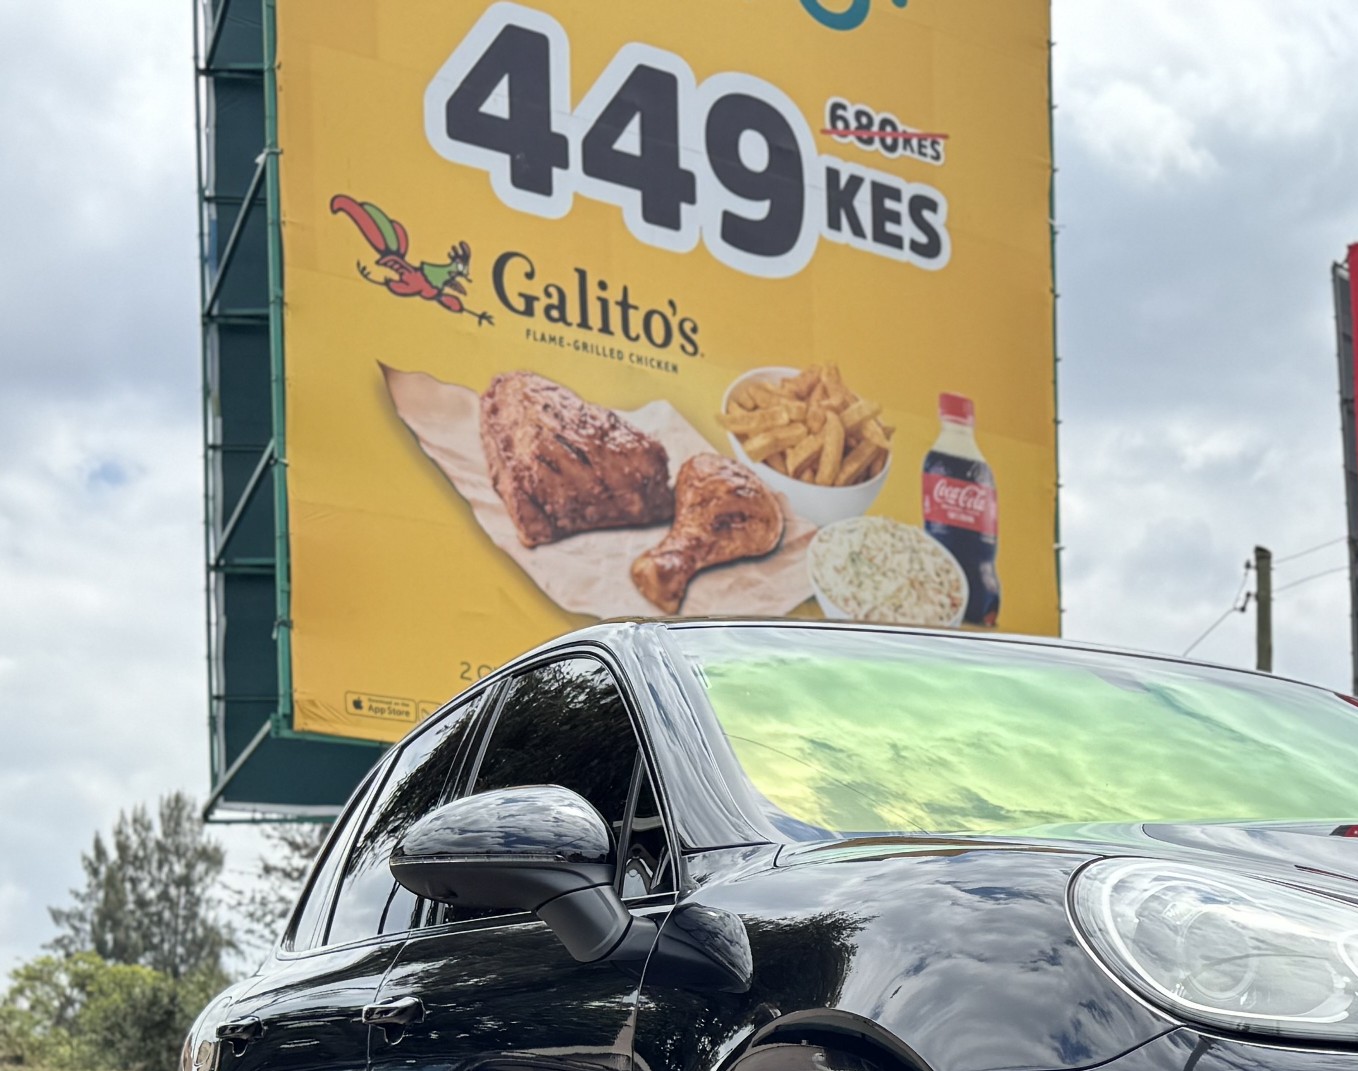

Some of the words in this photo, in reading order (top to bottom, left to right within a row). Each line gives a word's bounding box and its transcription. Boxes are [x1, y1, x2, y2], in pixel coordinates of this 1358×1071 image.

[446, 23, 805, 259] 449
[825, 166, 942, 260] KES
[492, 251, 700, 358] Galito's
[526, 328, 625, 361] FLAME-GRILLED
[629, 352, 679, 374] CHICKEN
[368, 703, 386, 716] App
[387, 704, 411, 718] Store
